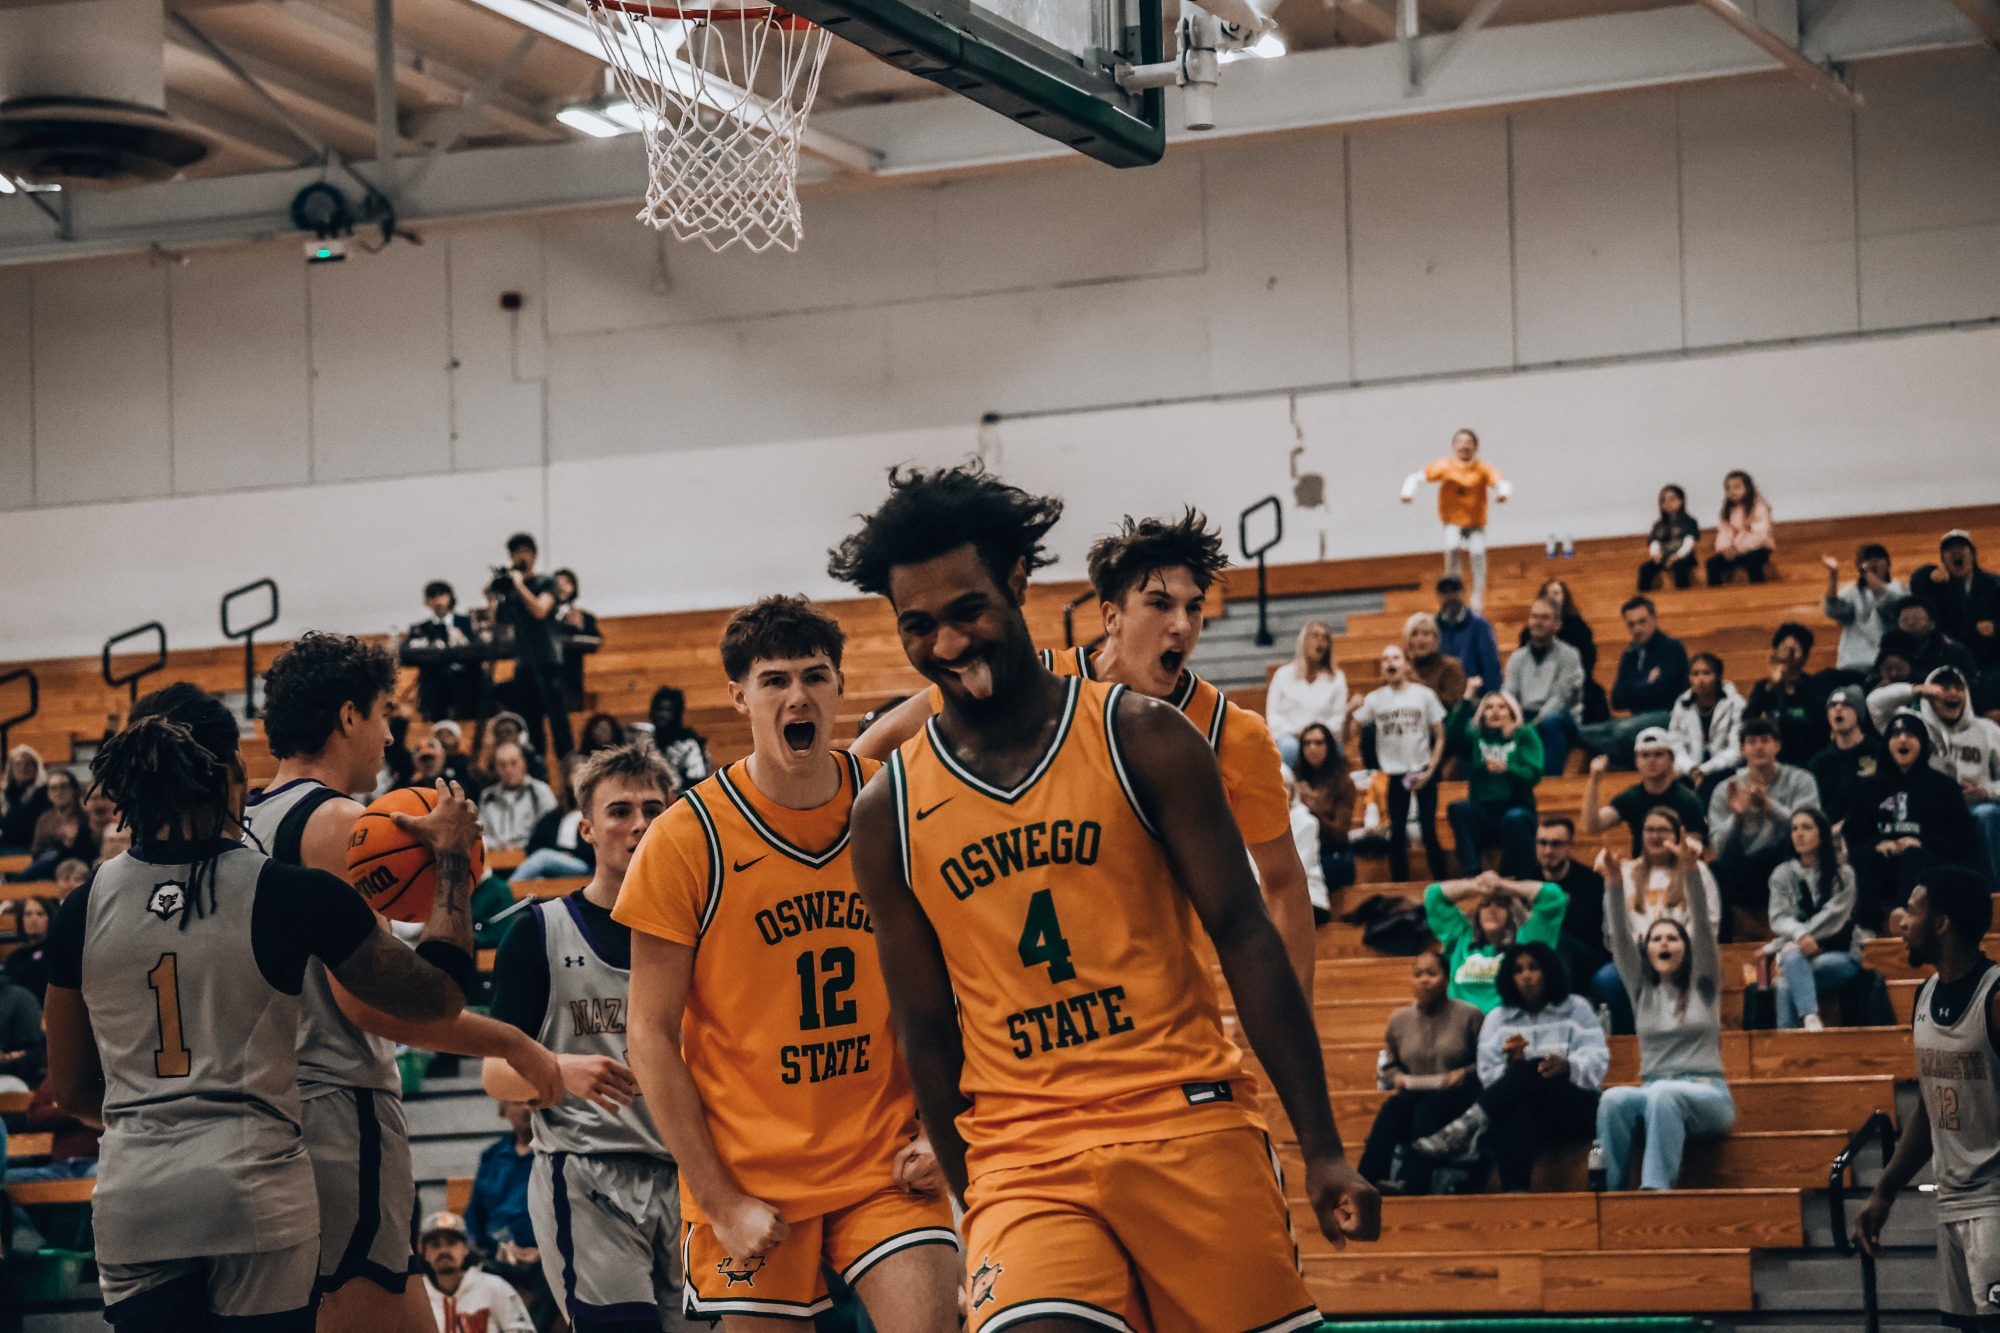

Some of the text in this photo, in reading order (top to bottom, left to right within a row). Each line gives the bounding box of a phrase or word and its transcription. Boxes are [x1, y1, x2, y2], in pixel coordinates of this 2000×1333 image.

[939, 819, 1102, 901] OSWEGO
[1017, 888, 1077, 984] 4
[147, 952, 192, 1079] 1
[570, 998, 628, 1037] NAZ
[796, 946, 858, 1031] 12
[1006, 985, 1135, 1060] STATE
[780, 1033, 871, 1085] STATE
[1935, 1085, 1961, 1131] 12
